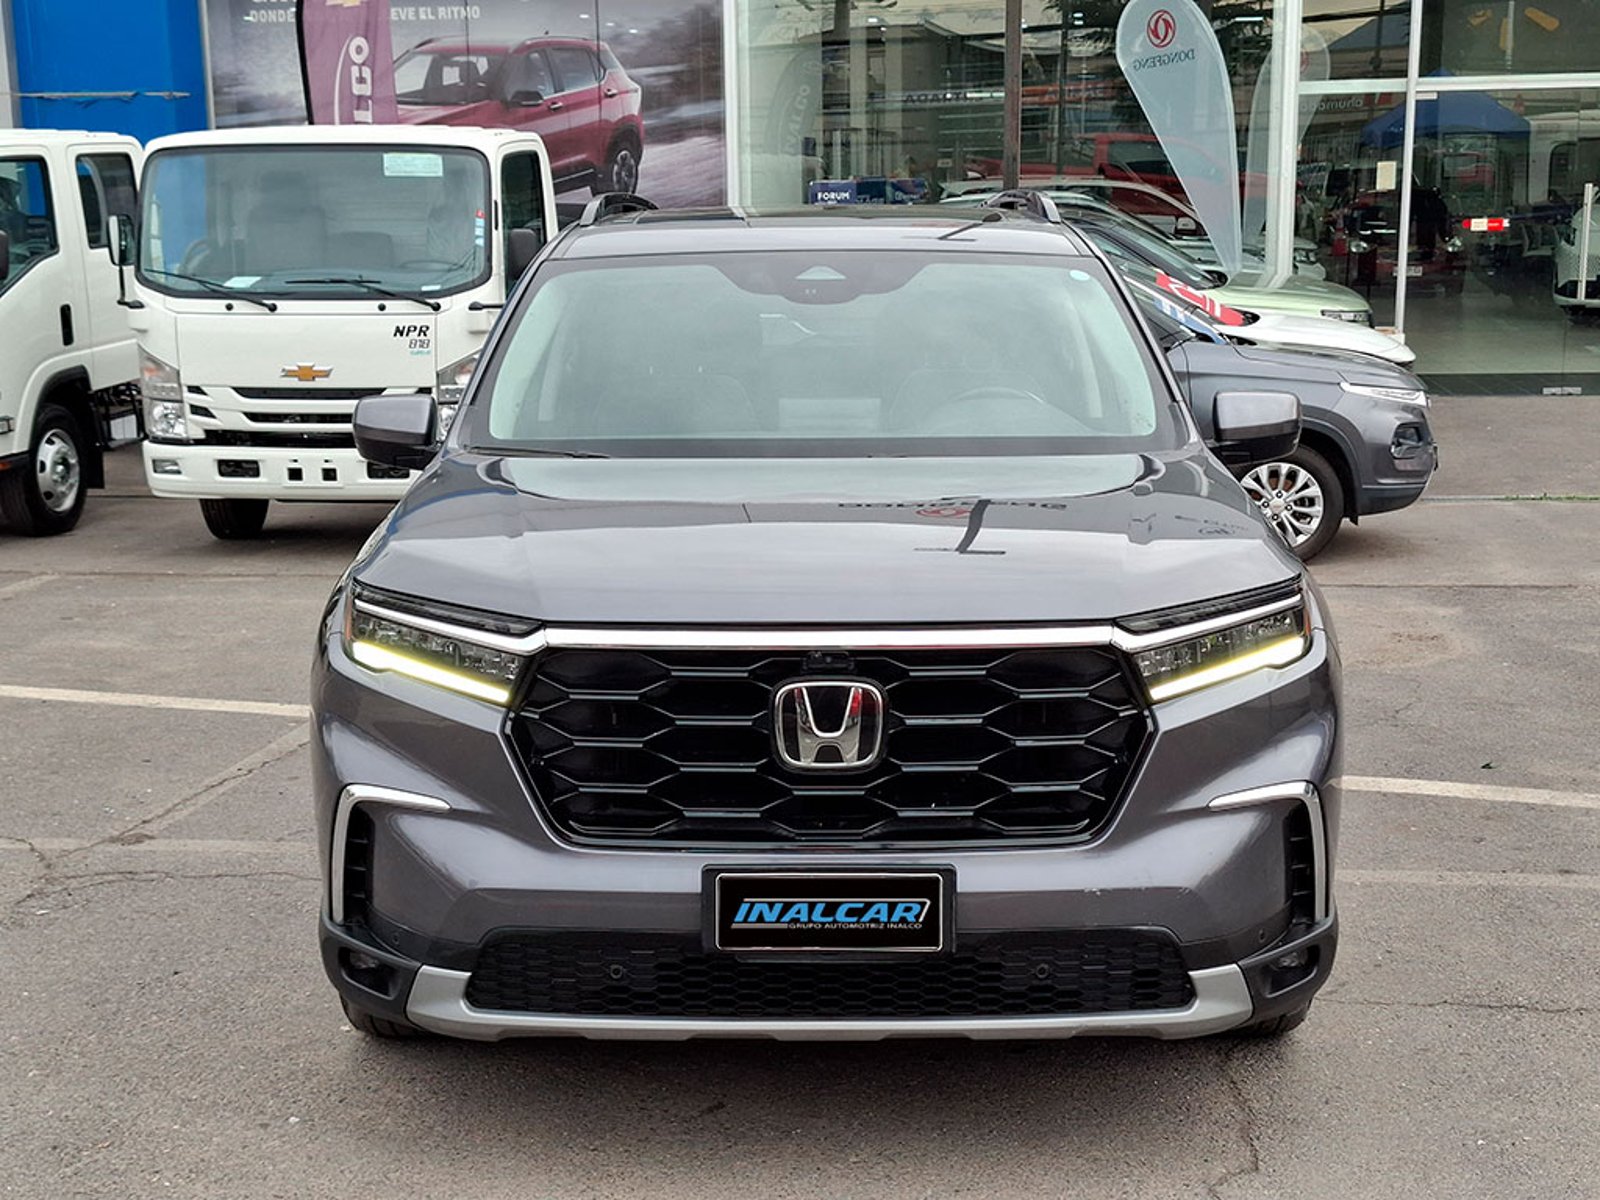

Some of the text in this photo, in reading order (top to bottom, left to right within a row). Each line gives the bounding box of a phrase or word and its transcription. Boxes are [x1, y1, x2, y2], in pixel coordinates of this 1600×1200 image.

[250, 10, 296, 23] DONDE
[418, 6, 435, 20] EL
[438, 5, 481, 20] RITMO
[817, 191, 850, 201] FORUM
[393, 324, 430, 338] NPR
[408, 338, 431, 349] 818
[734, 902, 921, 923] INALCAR
